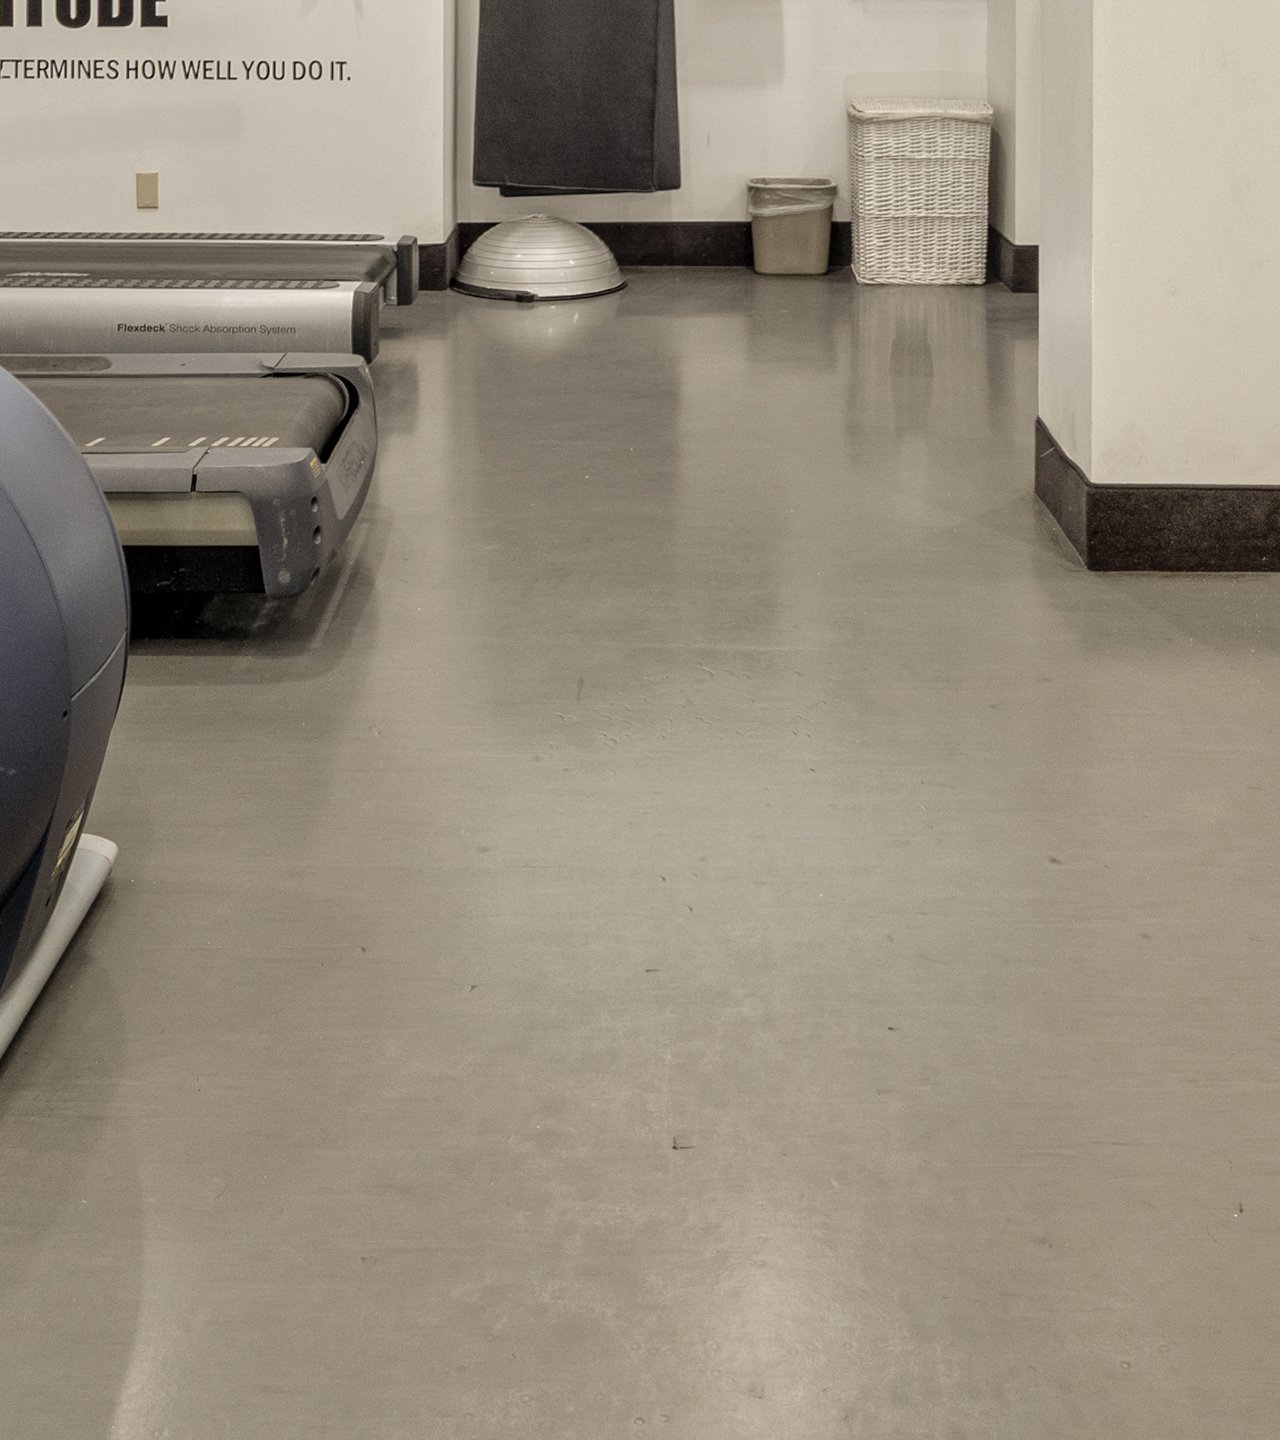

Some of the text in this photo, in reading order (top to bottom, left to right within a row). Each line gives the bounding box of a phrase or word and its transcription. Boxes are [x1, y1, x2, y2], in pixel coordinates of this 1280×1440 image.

[125, 59, 177, 80] HOW
[181, 60, 238, 80] WELL
[241, 60, 286, 81] YOU
[292, 60, 323, 81] DO
[330, 60, 351, 81] IT.
[117, 322, 166, 333] Flexdeck
[203, 323, 257, 336] Absorption
[259, 324, 297, 337] System
